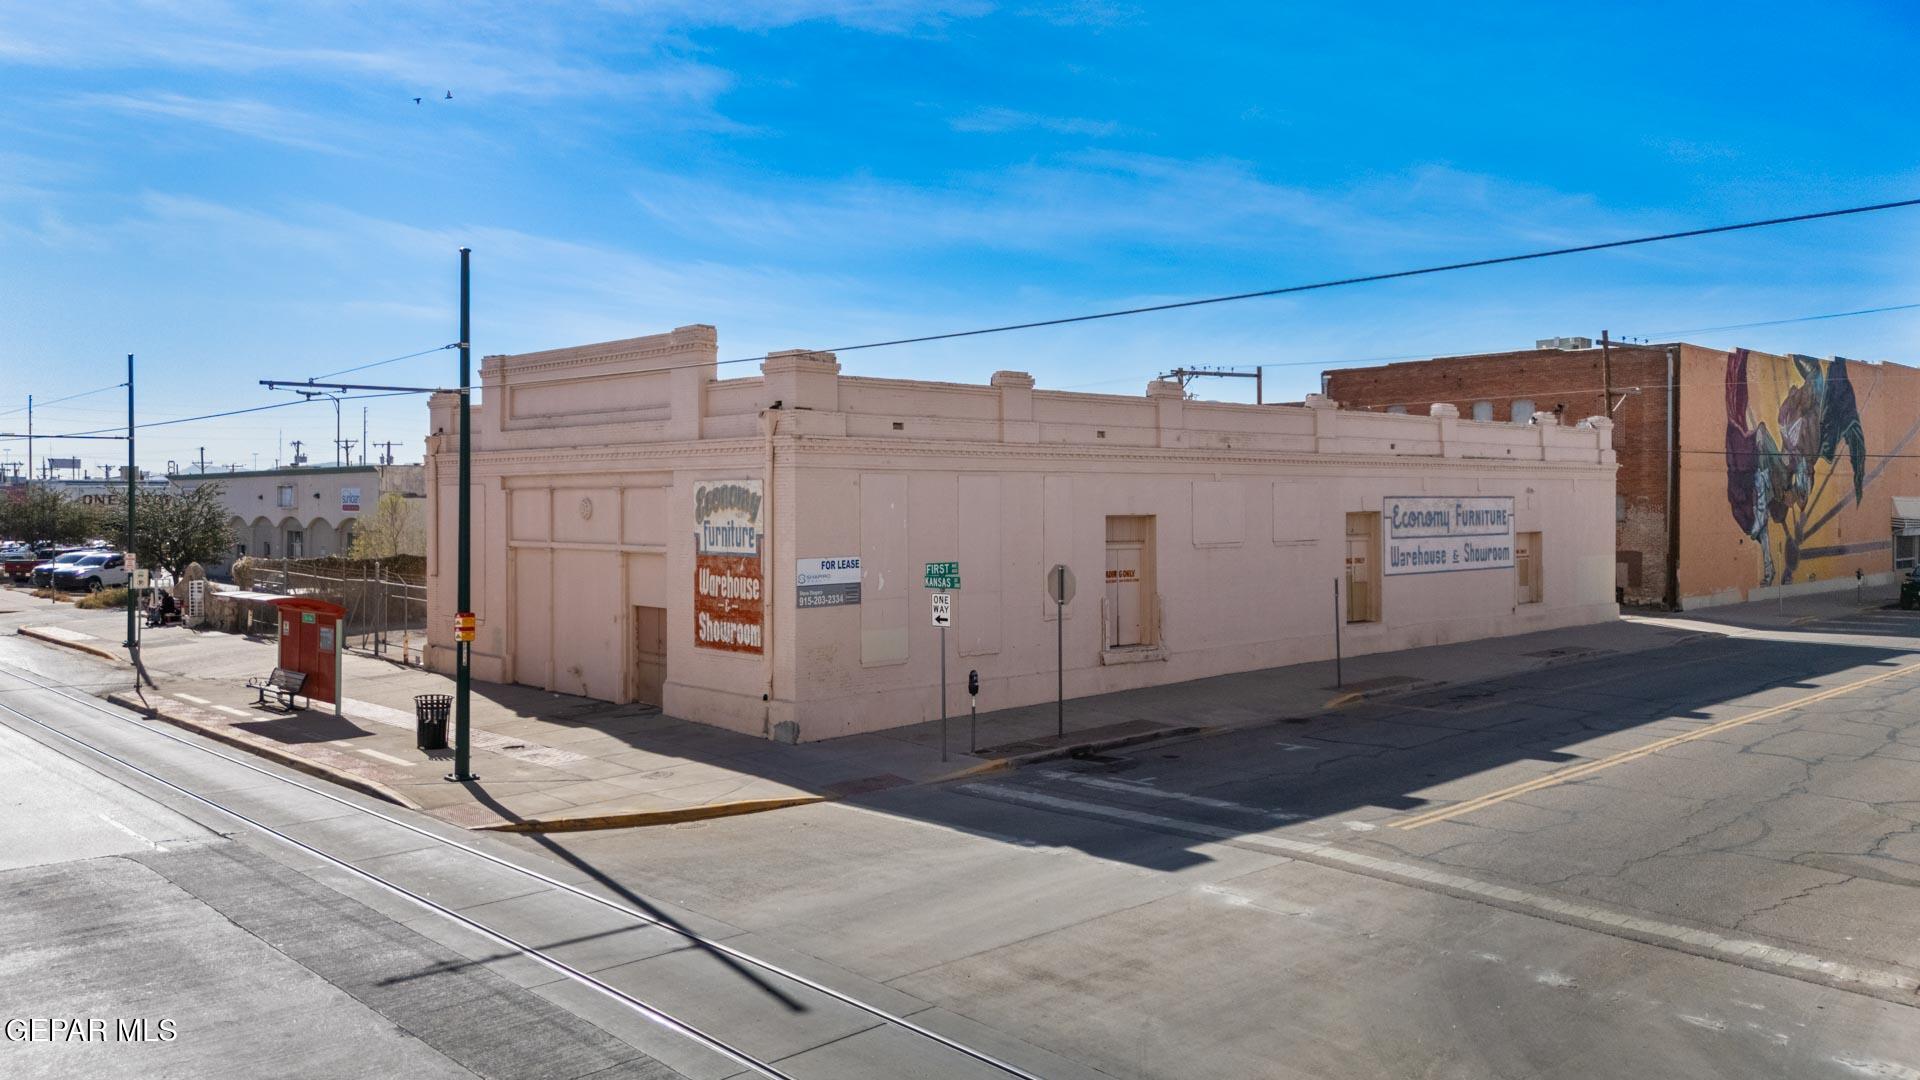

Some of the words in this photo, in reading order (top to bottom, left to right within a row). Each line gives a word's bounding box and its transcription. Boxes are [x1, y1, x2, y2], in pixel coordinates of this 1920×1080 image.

[695, 484, 762, 525] Economy
[1392, 504, 1450, 533] Economy
[1455, 502, 1507, 527] FURNITURE
[1391, 545, 1447, 567] Warehouse
[1452, 549, 1460, 563] &
[1464, 542, 1510, 562] Showroom
[821, 560, 836, 570] FOR
[837, 559, 860, 569] LEASE
[926, 564, 950, 575] FIRST
[699, 567, 760, 600] Warehouse
[925, 577, 951, 588] KANSAS
[799, 594, 844, 606] 915-203-2334
[933, 595, 949, 604] ONE
[933, 605, 949, 614] WAY
[699, 611, 761, 647] Showroom
